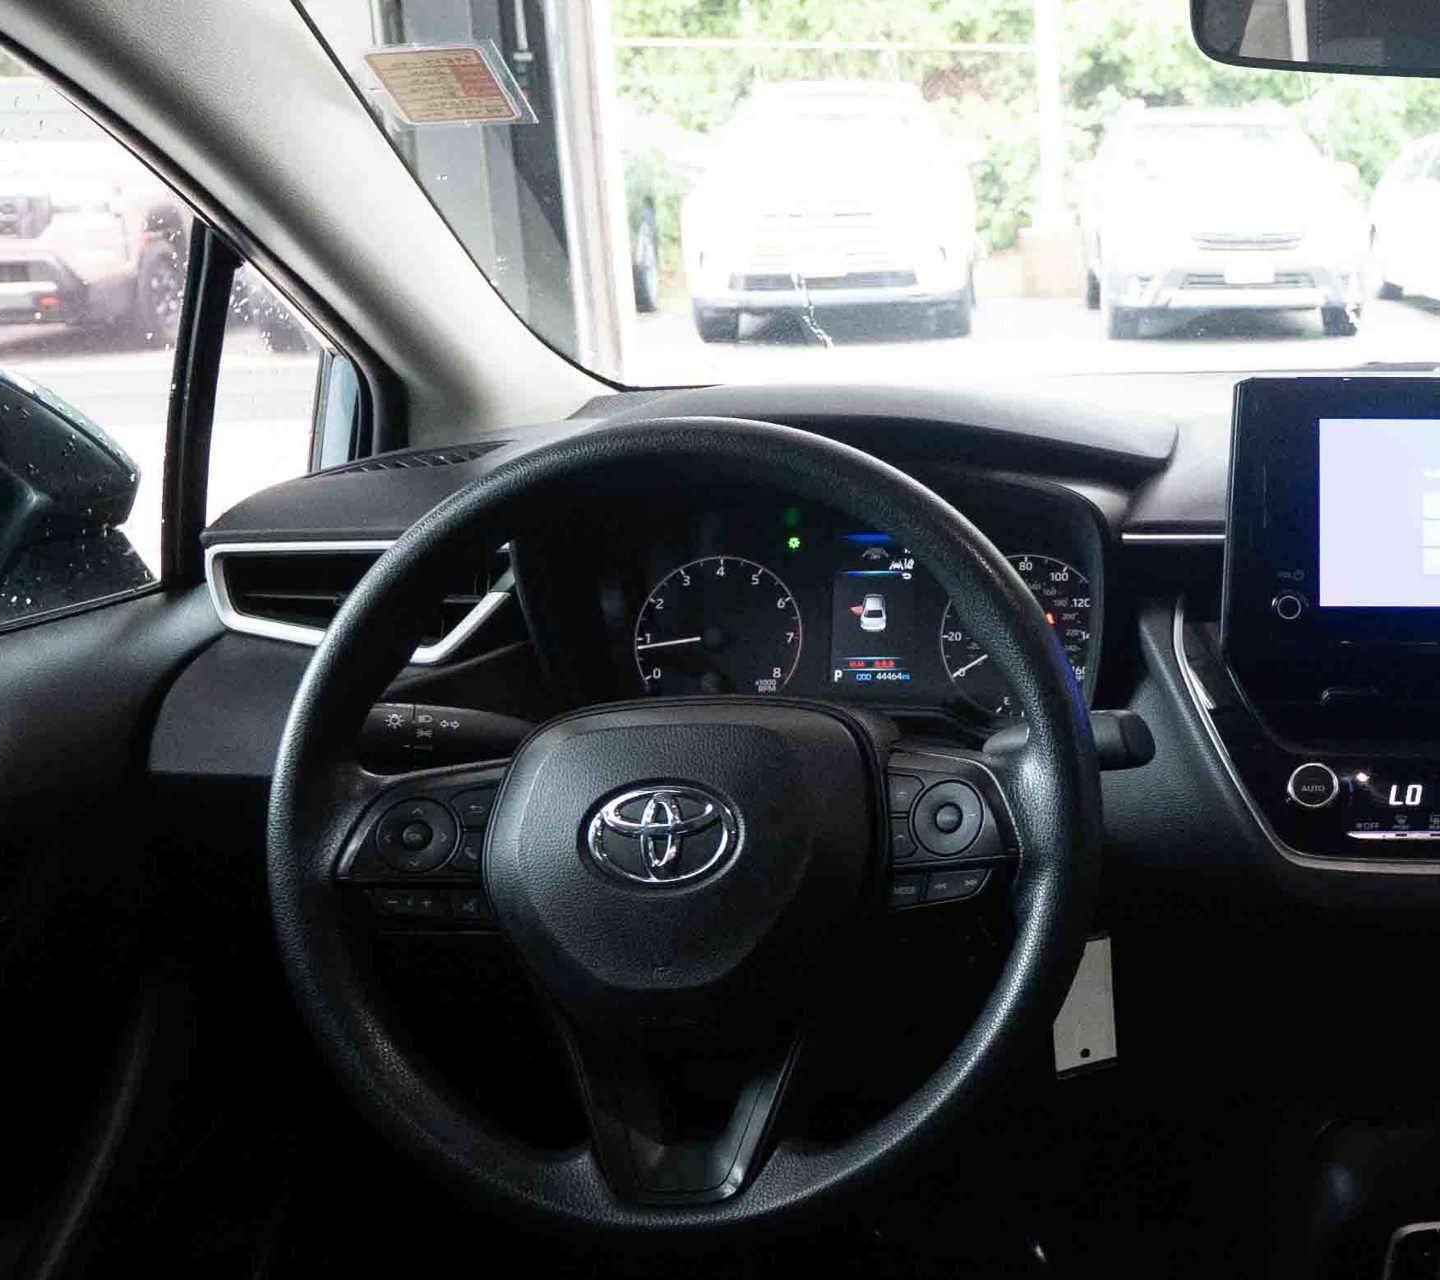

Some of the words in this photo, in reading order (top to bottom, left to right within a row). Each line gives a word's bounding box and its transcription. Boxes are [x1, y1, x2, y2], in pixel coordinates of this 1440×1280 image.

[1018, 561, 1033, 571] 80
[716, 567, 725, 577] 4
[1050, 572, 1069, 582] 100
[682, 576, 691, 586] 3
[751, 574, 760, 585] 5
[655, 599, 664, 610] 2
[777, 598, 786, 609] 6
[645, 633, 652, 644] 1
[786, 632, 794, 643] 7
[948, 632, 962, 642] 20
[652, 668, 661, 679] 0
[772, 668, 782, 679] 8
[834, 669, 843, 682] P
[1301, 784, 1326, 793] AUTO
[1388, 784, 1423, 806] LO
[1364, 822, 1380, 830] OFF
